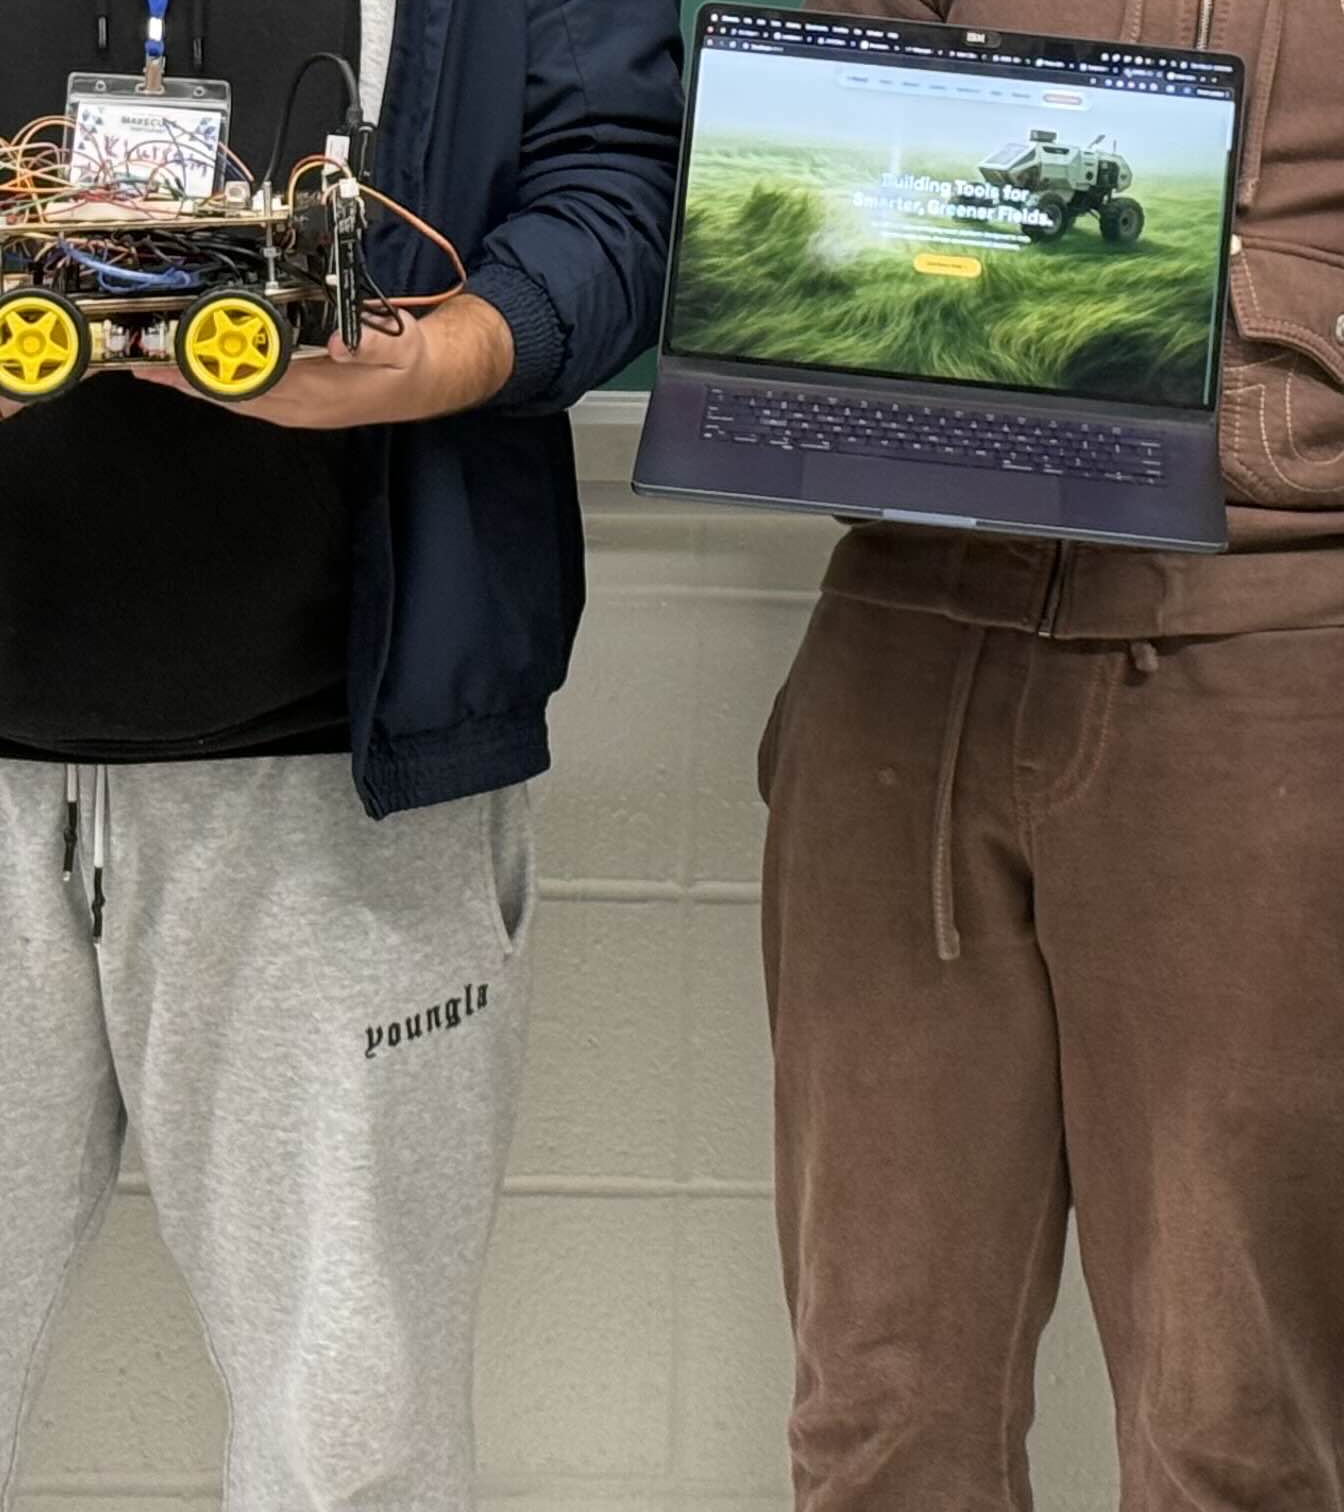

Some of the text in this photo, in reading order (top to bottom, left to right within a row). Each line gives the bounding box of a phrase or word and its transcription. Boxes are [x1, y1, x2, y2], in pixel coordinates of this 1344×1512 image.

[955, 179, 1000, 199] Tools
[1003, 184, 1030, 202] for
[927, 199, 995, 220] Greener
[365, 983, 488, 1059] youngla
